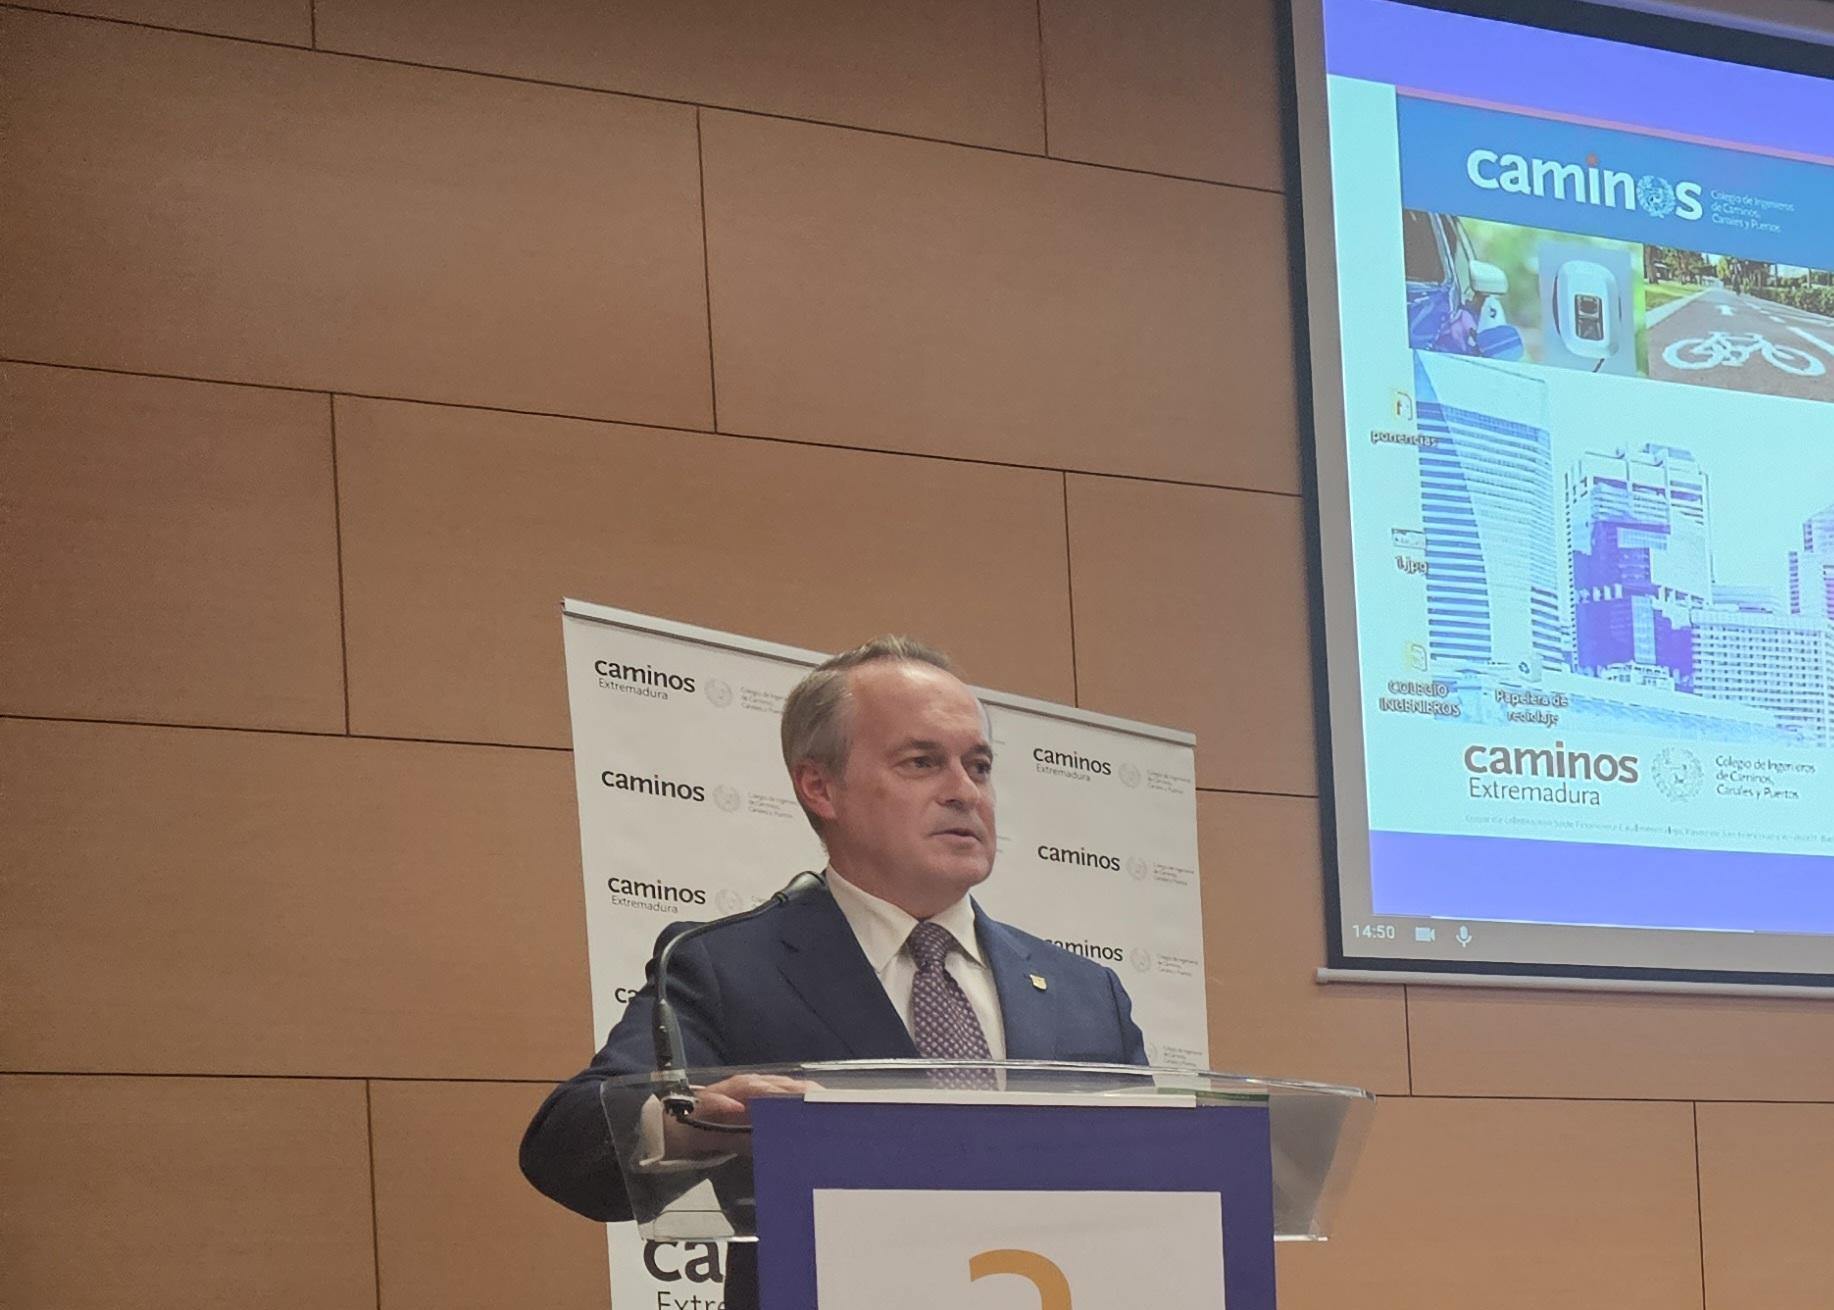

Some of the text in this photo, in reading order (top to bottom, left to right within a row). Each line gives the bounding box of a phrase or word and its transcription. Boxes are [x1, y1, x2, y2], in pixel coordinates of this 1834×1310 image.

[595, 660, 695, 693] caminos
[599, 678, 668, 700] Extremadura
[1033, 748, 1111, 775] caminos
[1036, 764, 1091, 782] Extremadura
[1464, 741, 1639, 784] caminos
[601, 770, 704, 802] caminos
[1469, 777, 1600, 806] Extremadura
[1038, 845, 1120, 871] caminos
[608, 877, 706, 905] caminos
[611, 896, 678, 913] Extremadura
[1353, 925, 1395, 939] 14:50
